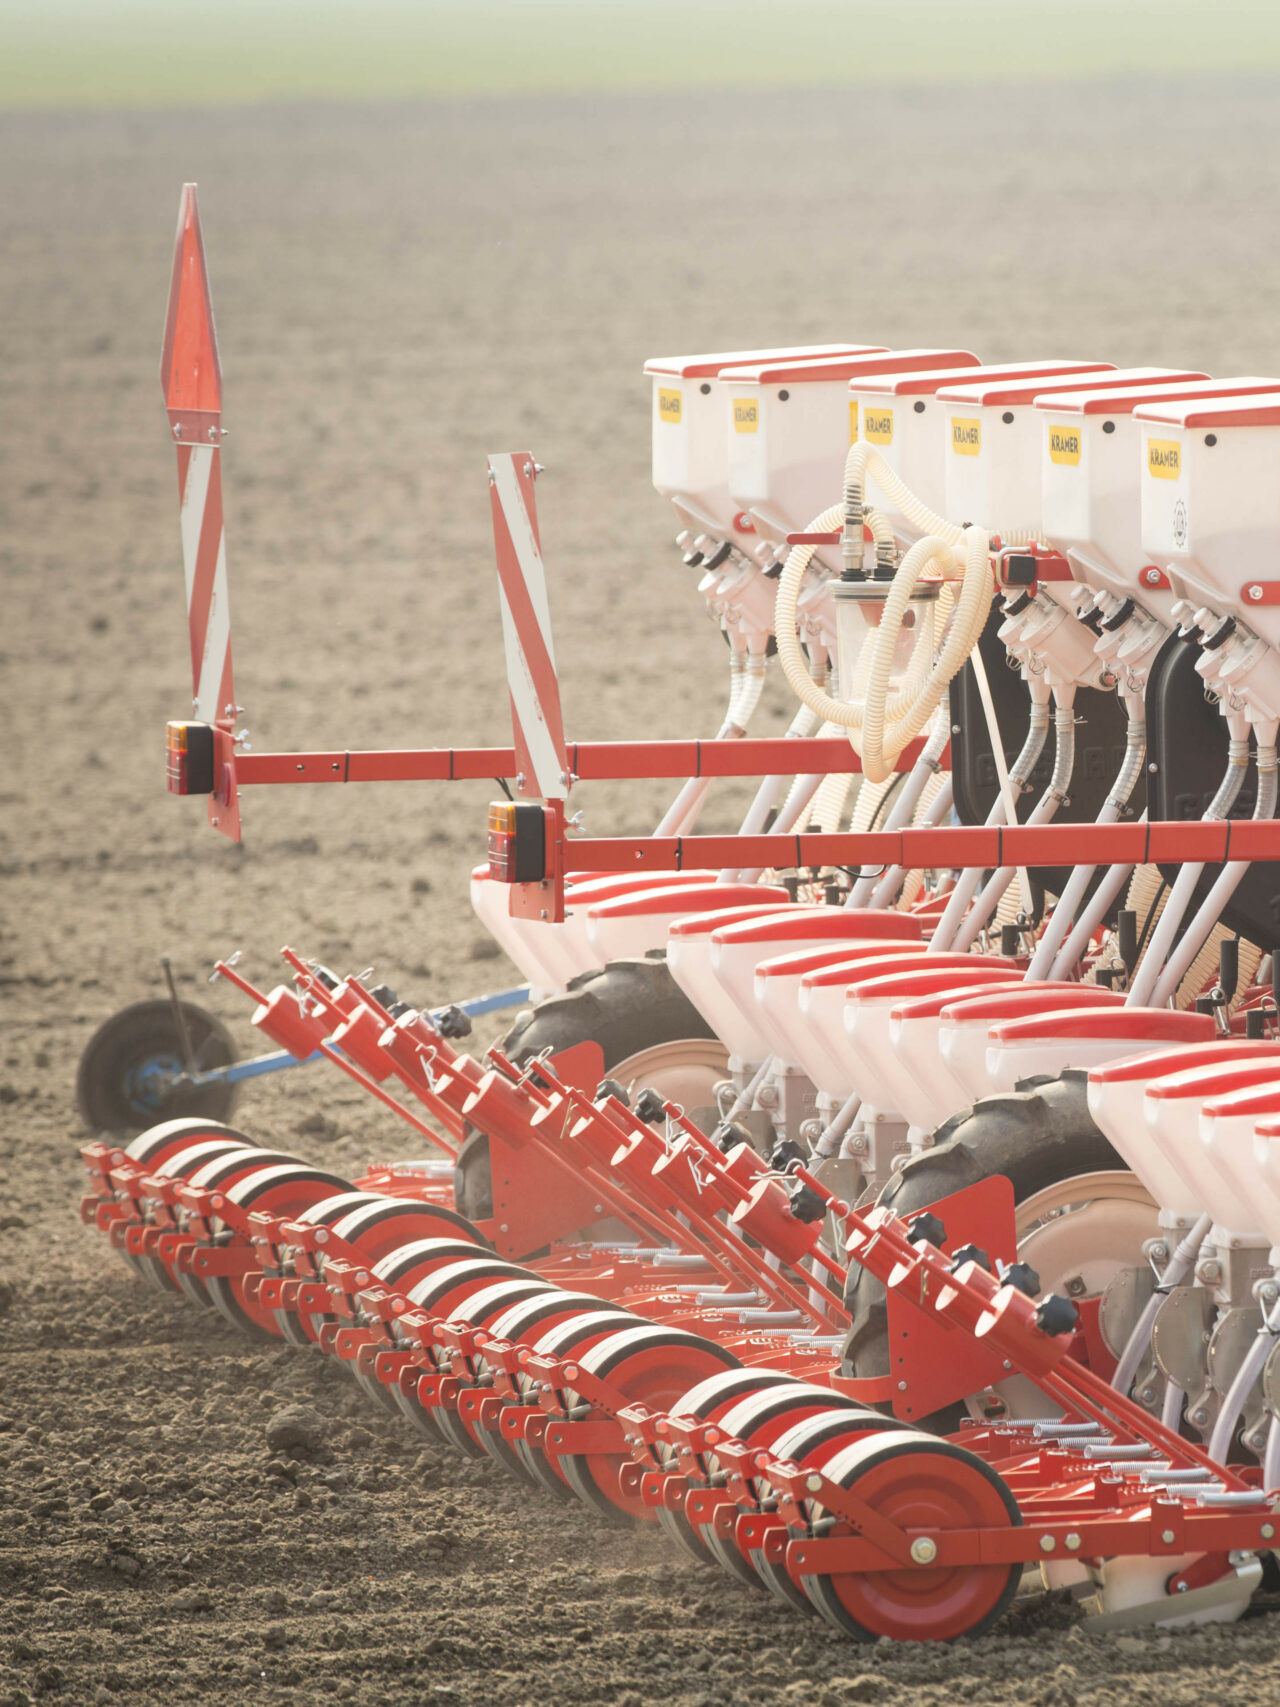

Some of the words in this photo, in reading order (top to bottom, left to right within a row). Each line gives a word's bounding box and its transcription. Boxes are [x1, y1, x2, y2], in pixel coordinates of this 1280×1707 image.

[660, 396, 680, 413] KRAMER
[735, 407, 757, 422] KRAMER
[866, 418, 892, 434] KRAMER
[953, 426, 979, 444] KRAMER
[1051, 435, 1079, 454] KRAMER
[1150, 449, 1178, 468] KRAMER
